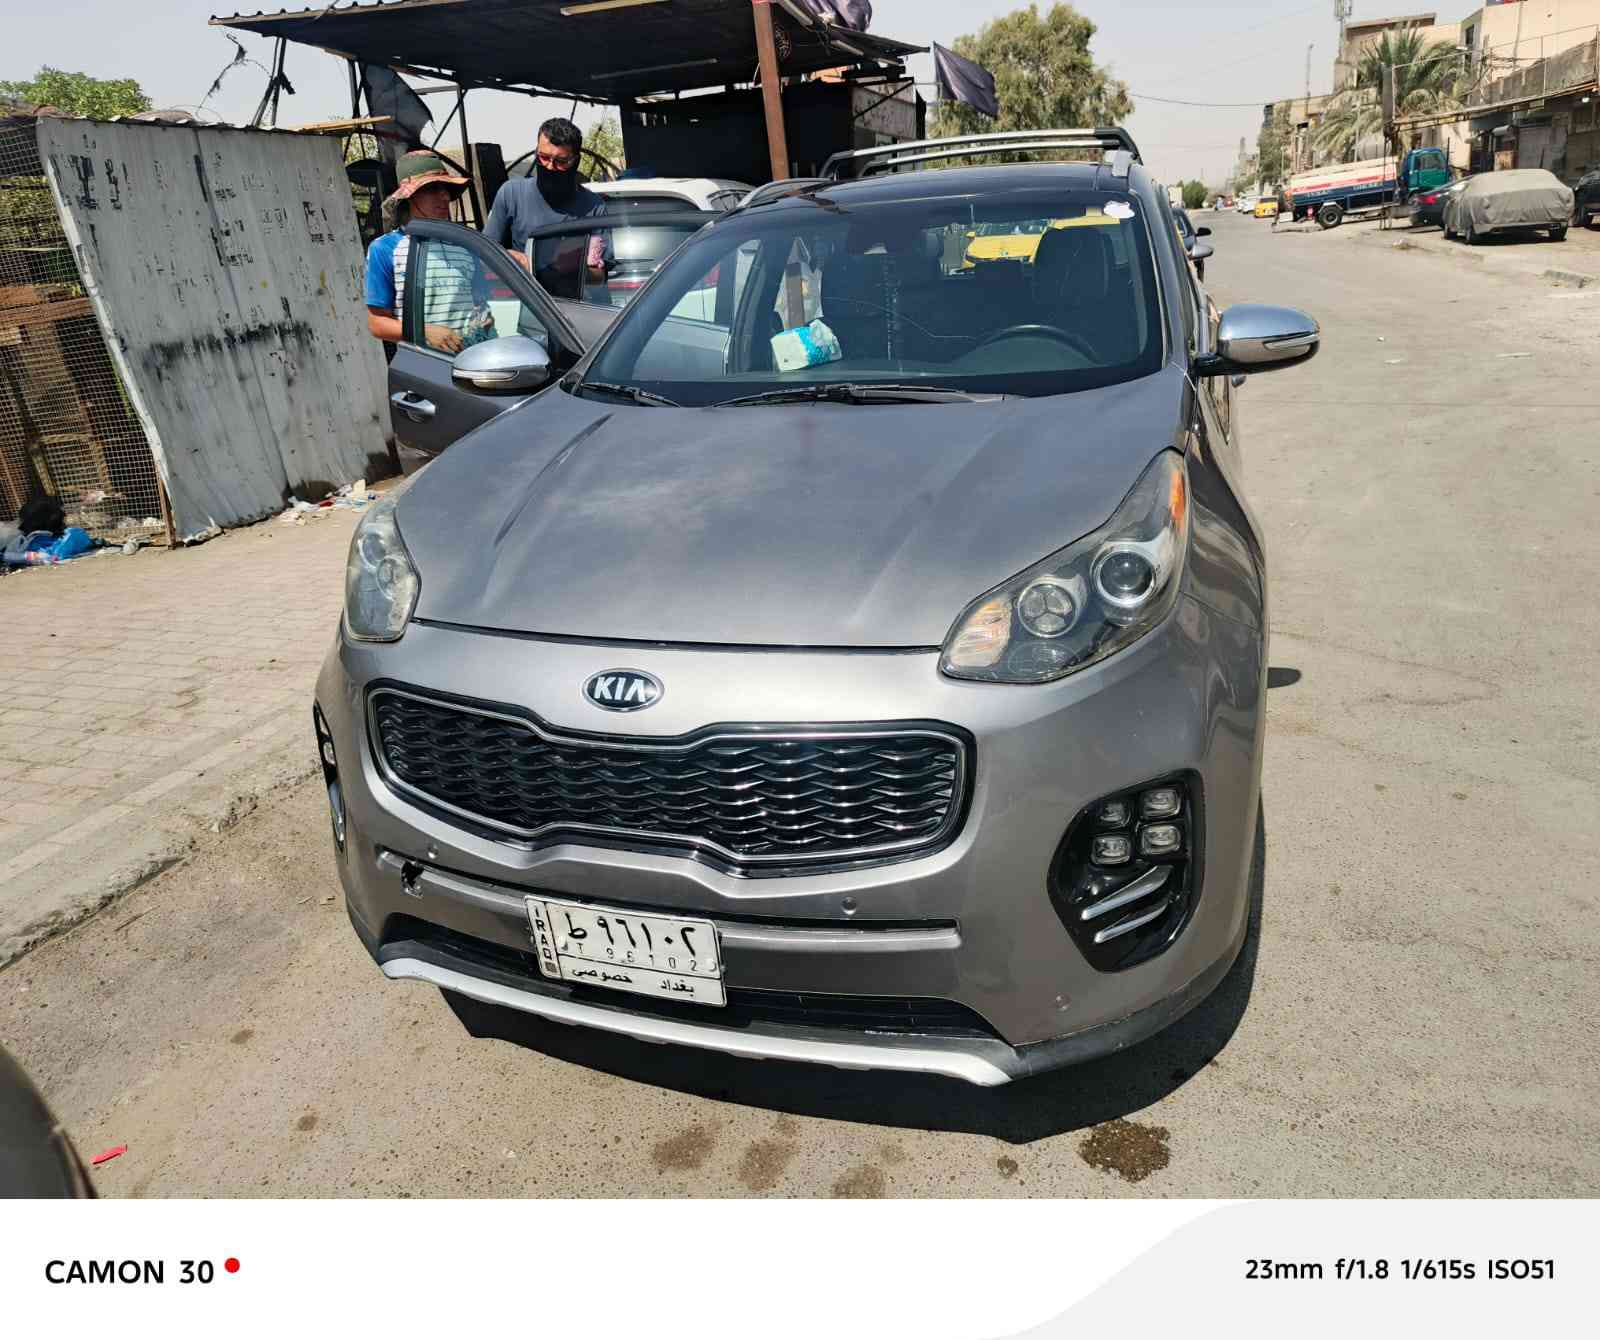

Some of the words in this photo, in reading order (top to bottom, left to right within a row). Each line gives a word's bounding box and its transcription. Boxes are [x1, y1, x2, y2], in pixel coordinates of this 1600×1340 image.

[593, 676, 646, 703] KIA
[534, 905, 552, 960] IRAQ
[660, 979, 695, 998] بغداد
